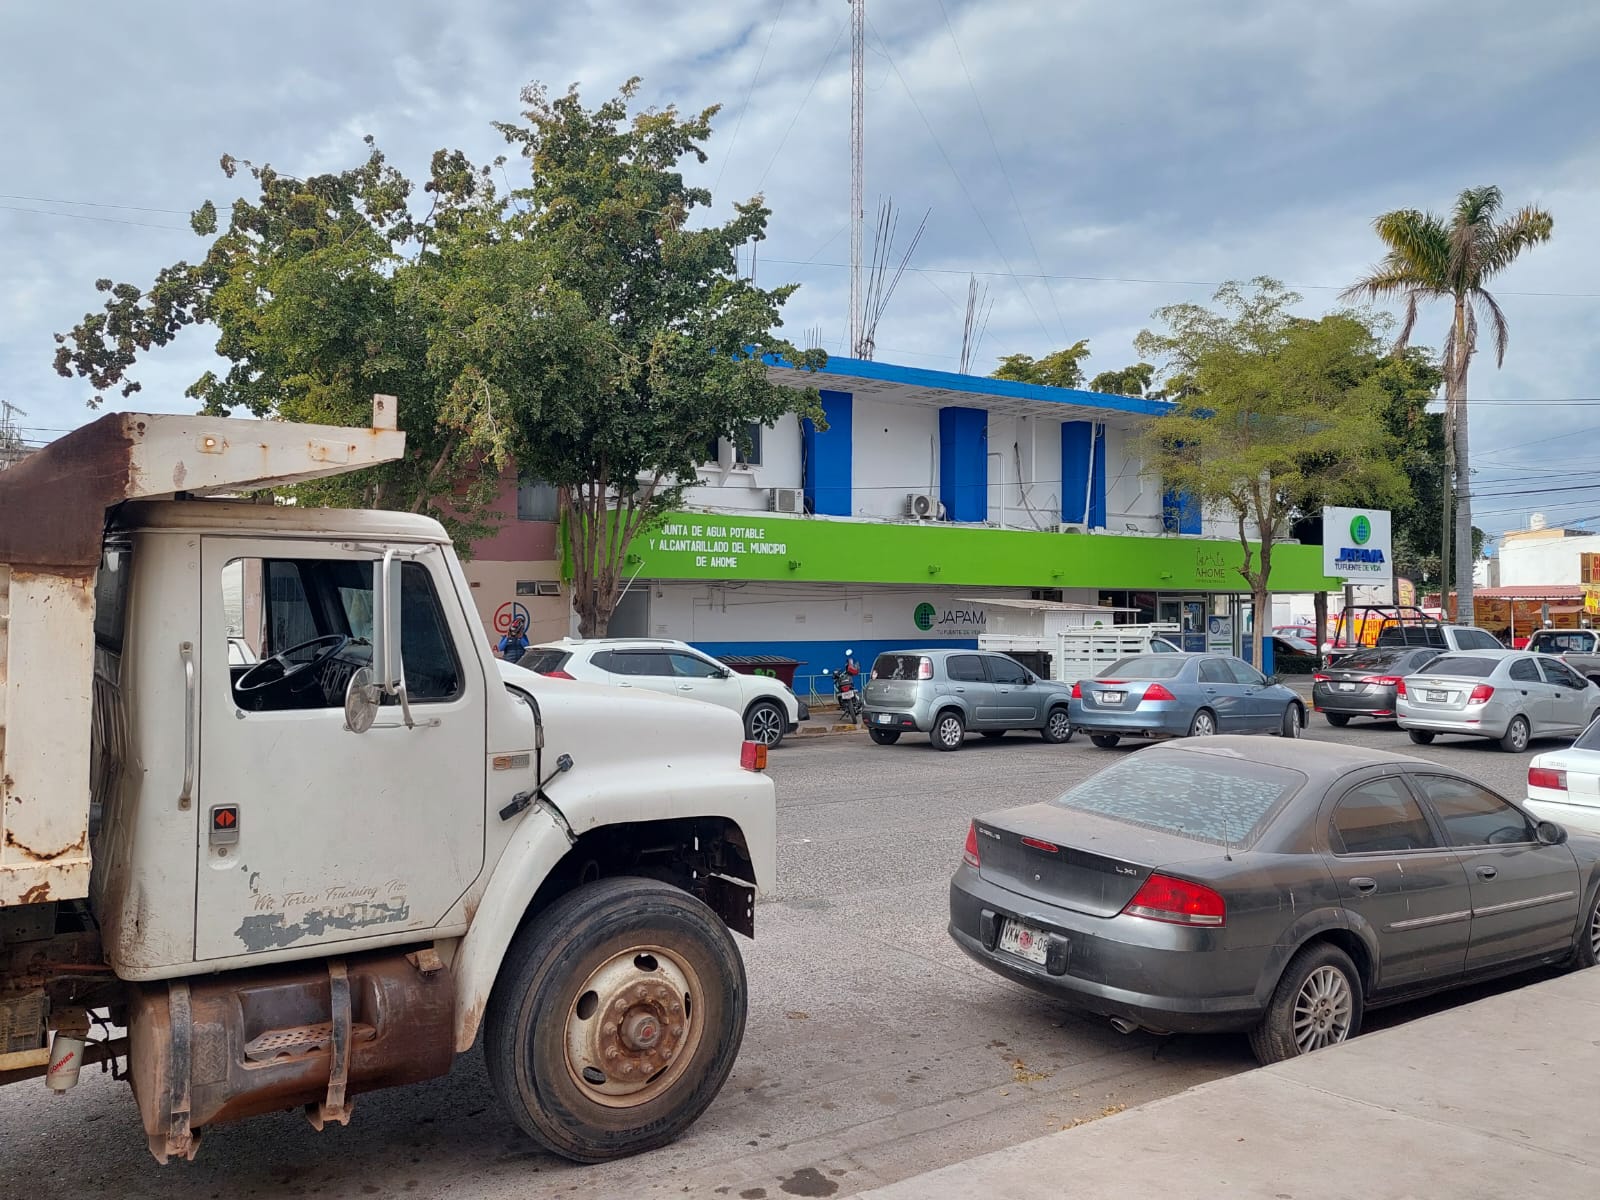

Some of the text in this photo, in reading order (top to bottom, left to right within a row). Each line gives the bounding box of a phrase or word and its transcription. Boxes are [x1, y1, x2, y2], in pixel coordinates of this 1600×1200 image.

[661, 524, 765, 540] JUNTA DE AGUA POTABLE
[649, 538, 787, 555] Y ALCANTARILLADO DEL MUNICIPIO
[695, 556, 738, 568] DE AHOME
[1335, 547, 1386, 563] JAPAMA
[938, 610, 987, 625] JAPAM
